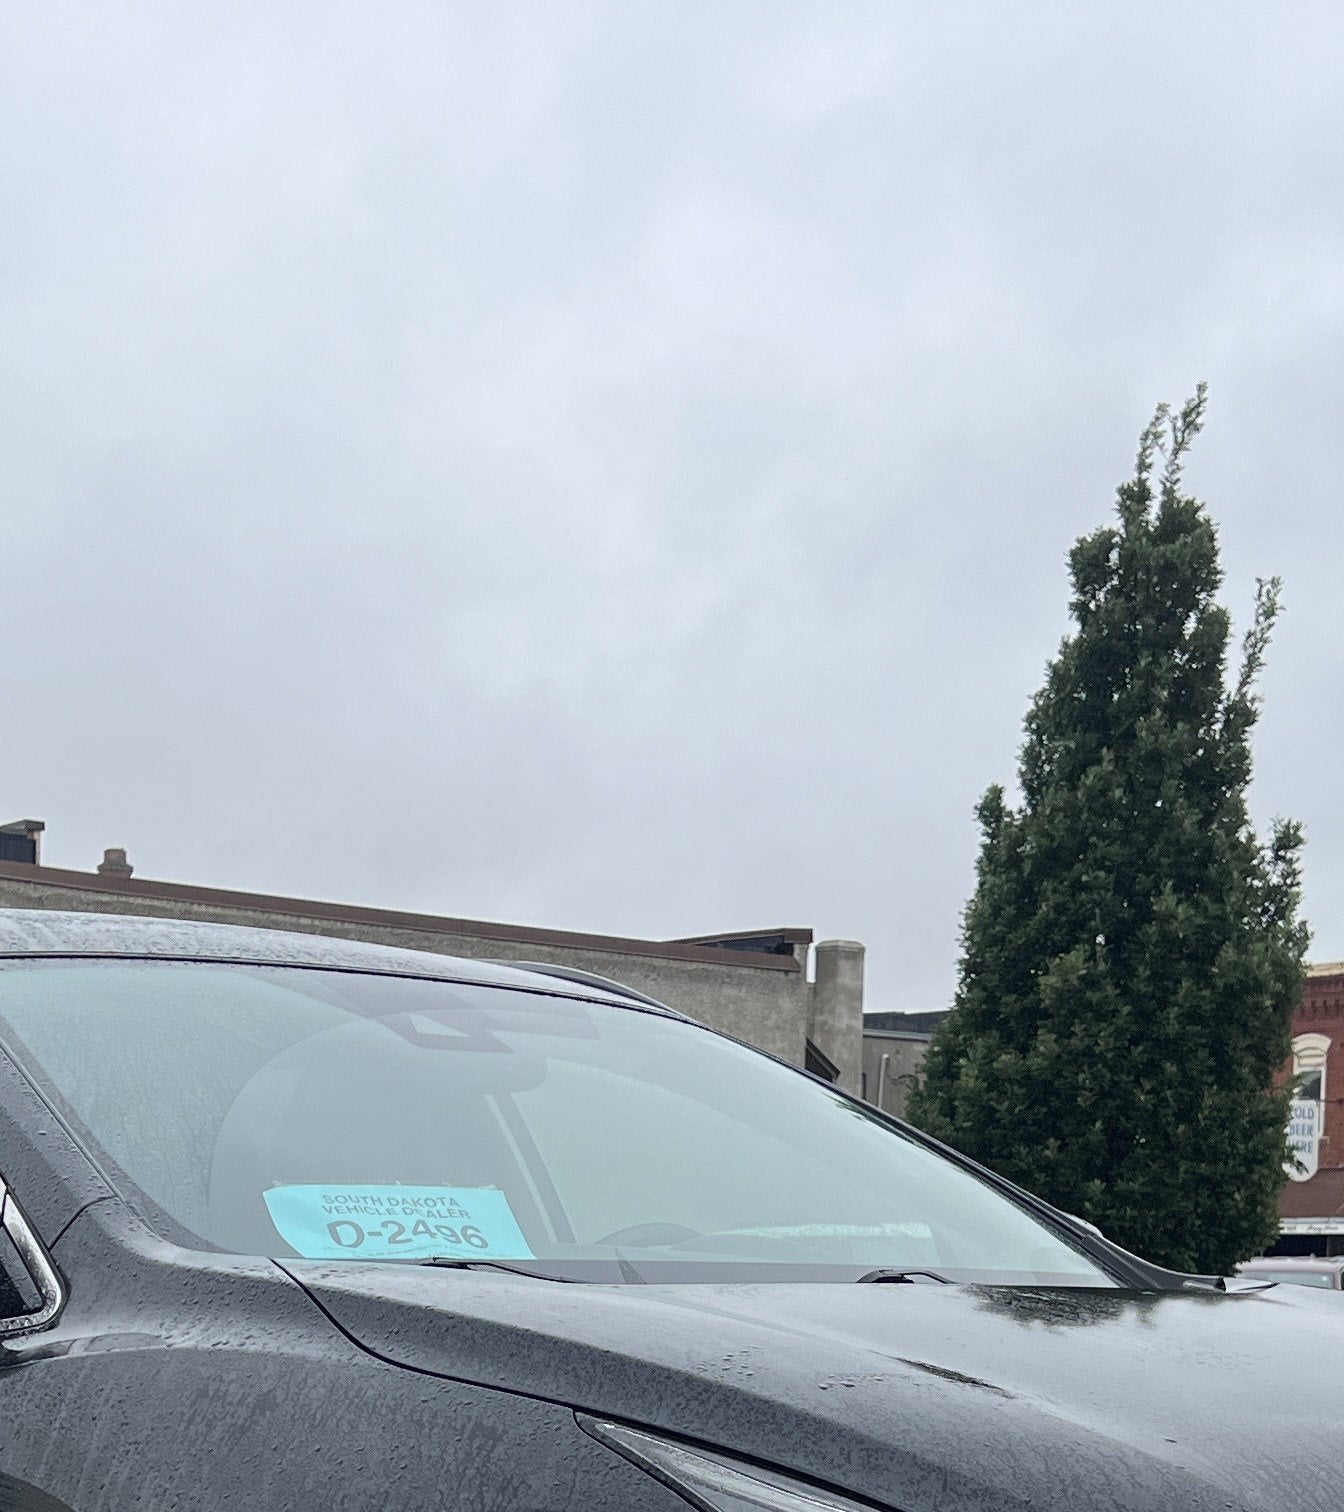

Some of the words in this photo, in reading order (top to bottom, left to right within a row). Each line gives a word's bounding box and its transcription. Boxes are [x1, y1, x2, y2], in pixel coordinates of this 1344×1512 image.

[321, 1194, 383, 1207] SOUTH
[387, 1197, 461, 1209] DAKOTA
[321, 1205, 397, 1216] VEHICLE
[327, 1219, 489, 1250] D-2496
